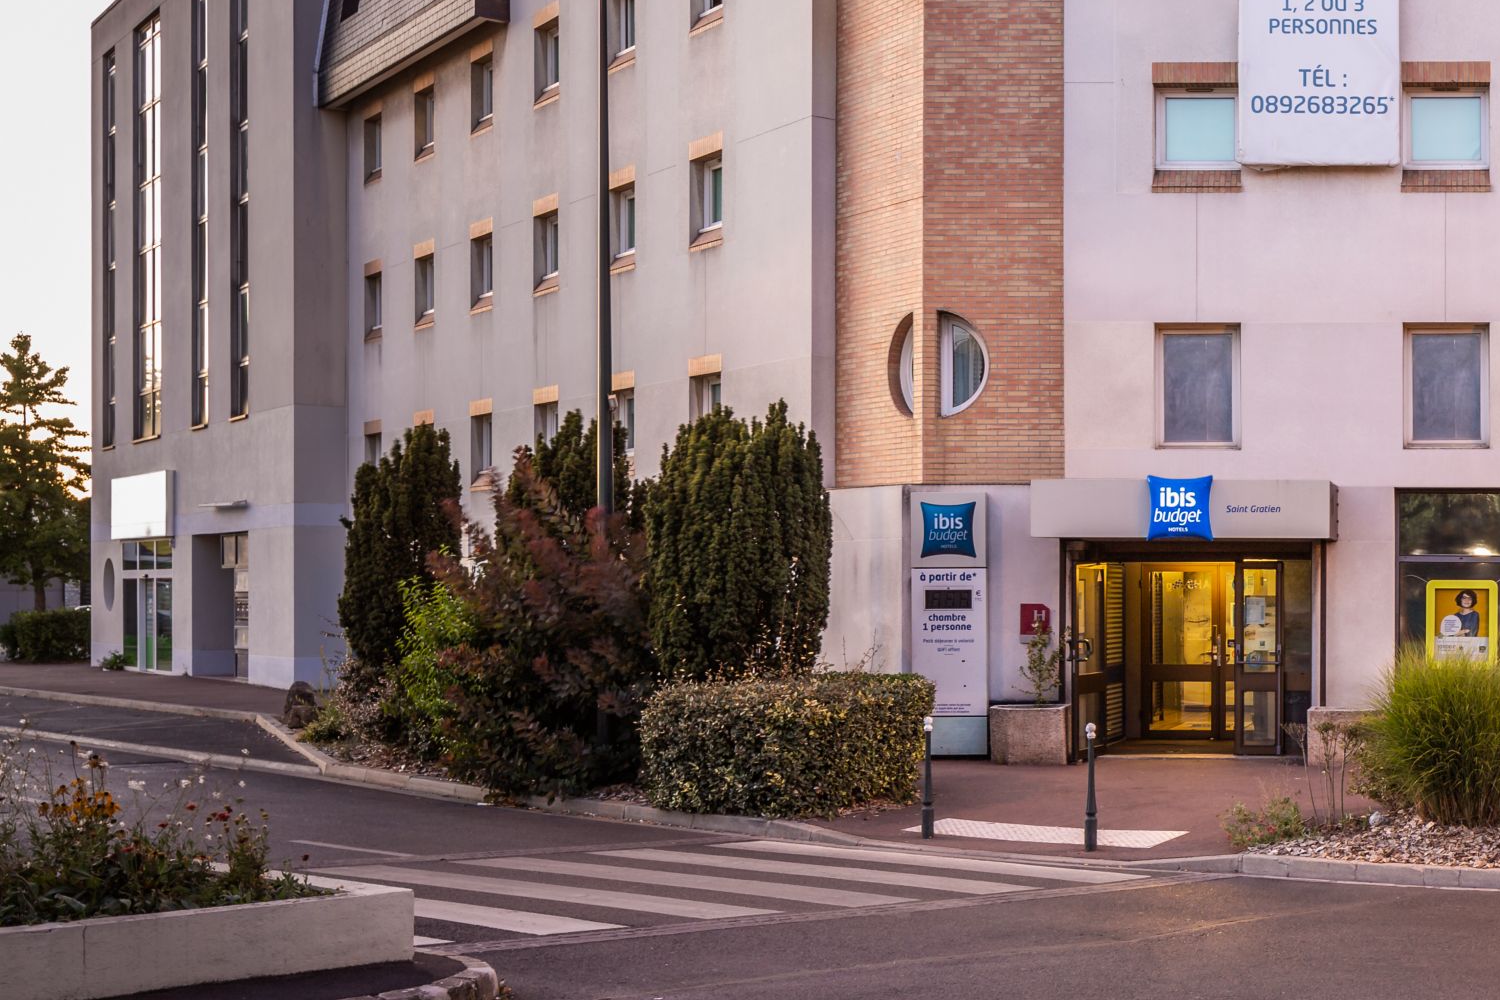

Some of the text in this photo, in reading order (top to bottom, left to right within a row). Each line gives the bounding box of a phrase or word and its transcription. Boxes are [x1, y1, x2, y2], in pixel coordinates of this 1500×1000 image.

[1269, 18, 1378, 35] PERSONNES
[1298, 65, 1336, 88] TÉL
[1159, 487, 1196, 508] ibis
[1226, 505, 1281, 513] Saint Gratien
[934, 513, 964, 529] ibis
[1153, 508, 1202, 526] budget
[928, 529, 968, 543] budget
[919, 572, 926, 581] à
[928, 572, 957, 583] partir
[928, 613, 967, 622] chambre
[1033, 609, 1046, 621] H
[930, 624, 972, 632] personne
